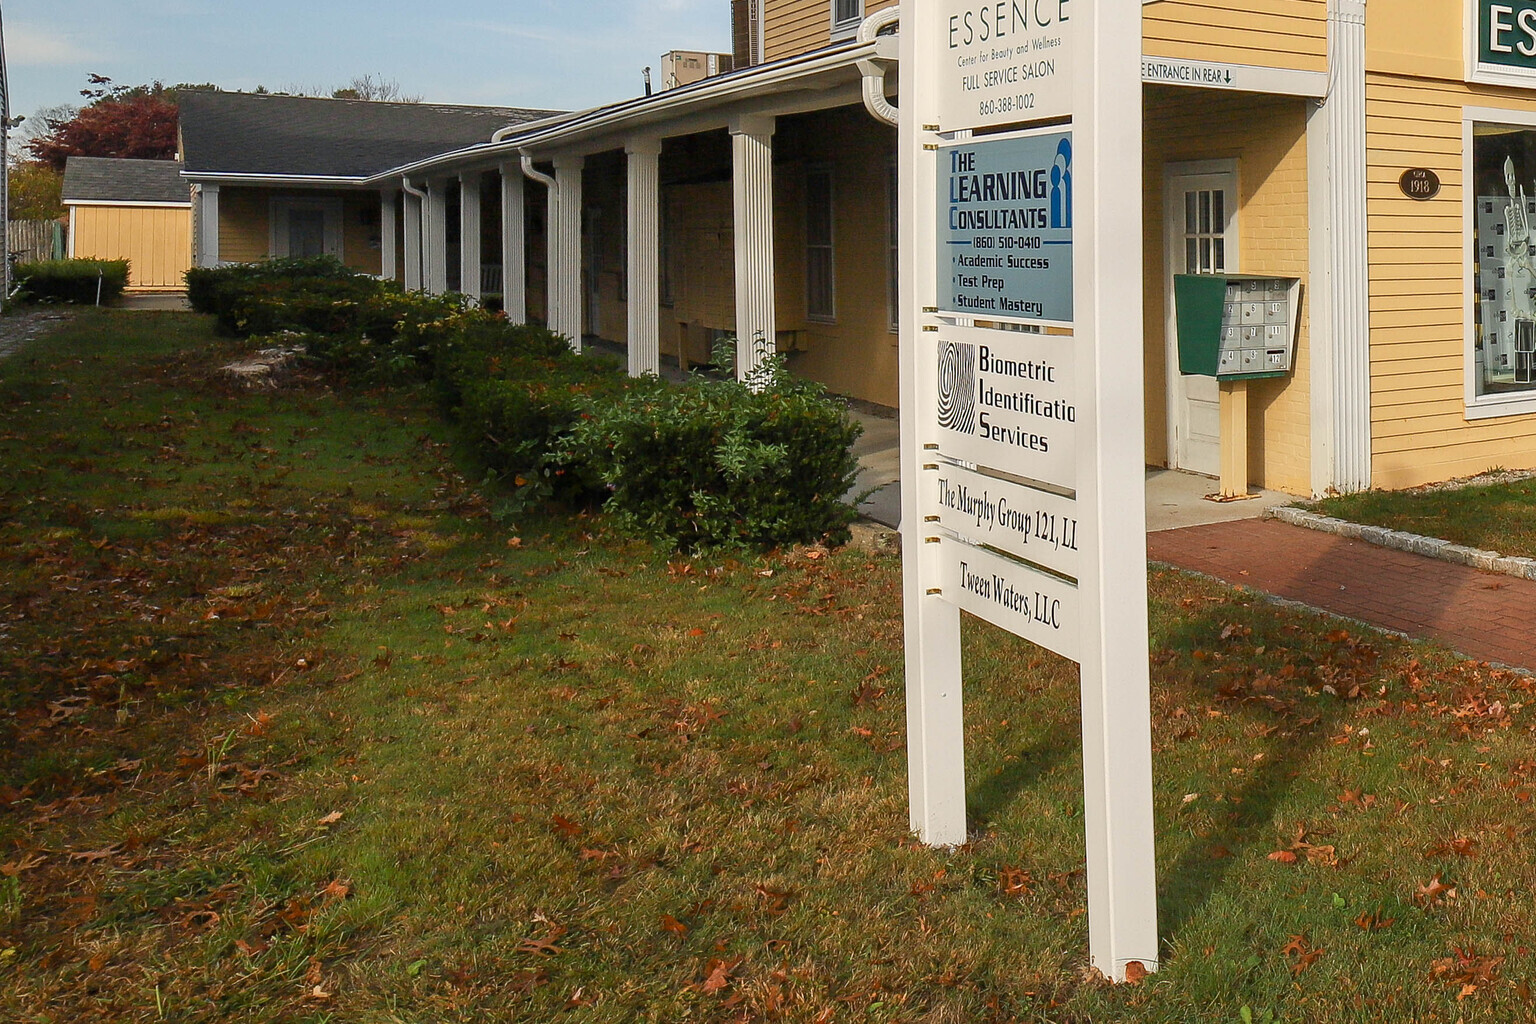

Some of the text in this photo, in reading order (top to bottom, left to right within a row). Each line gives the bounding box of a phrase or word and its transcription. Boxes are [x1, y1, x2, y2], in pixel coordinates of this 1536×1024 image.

[957, 36, 1061, 68] Center for Beauty and Wellness
[962, 58, 1055, 92] FULL SERVICE SALON
[1147, 63, 1190, 80] ENTRANCE
[1191, 67, 1201, 80] IN
[1202, 68, 1222, 83] REAR
[979, 92, 1035, 116] 860-388-1002
[950, 150, 976, 173] THE
[950, 170, 1047, 203] LEARNING
[1411, 180, 1430, 193] 1918
[950, 206, 1047, 230] CONSULTANTS
[973, 236, 1041, 249] (860) 510-0410
[957, 254, 1049, 270] Academic Success
[957, 274, 1004, 292] Test Prep
[957, 294, 1043, 317] Student Mastery
[979, 345, 1055, 383] Biometric
[979, 412, 1049, 453] Services
[938, 478, 956, 509] The
[957, 484, 996, 532] Murphy
[998, 497, 1032, 544] Group
[1034, 510, 1060, 551] 121,
[959, 561, 1061, 629] Tween Waters, LLC
